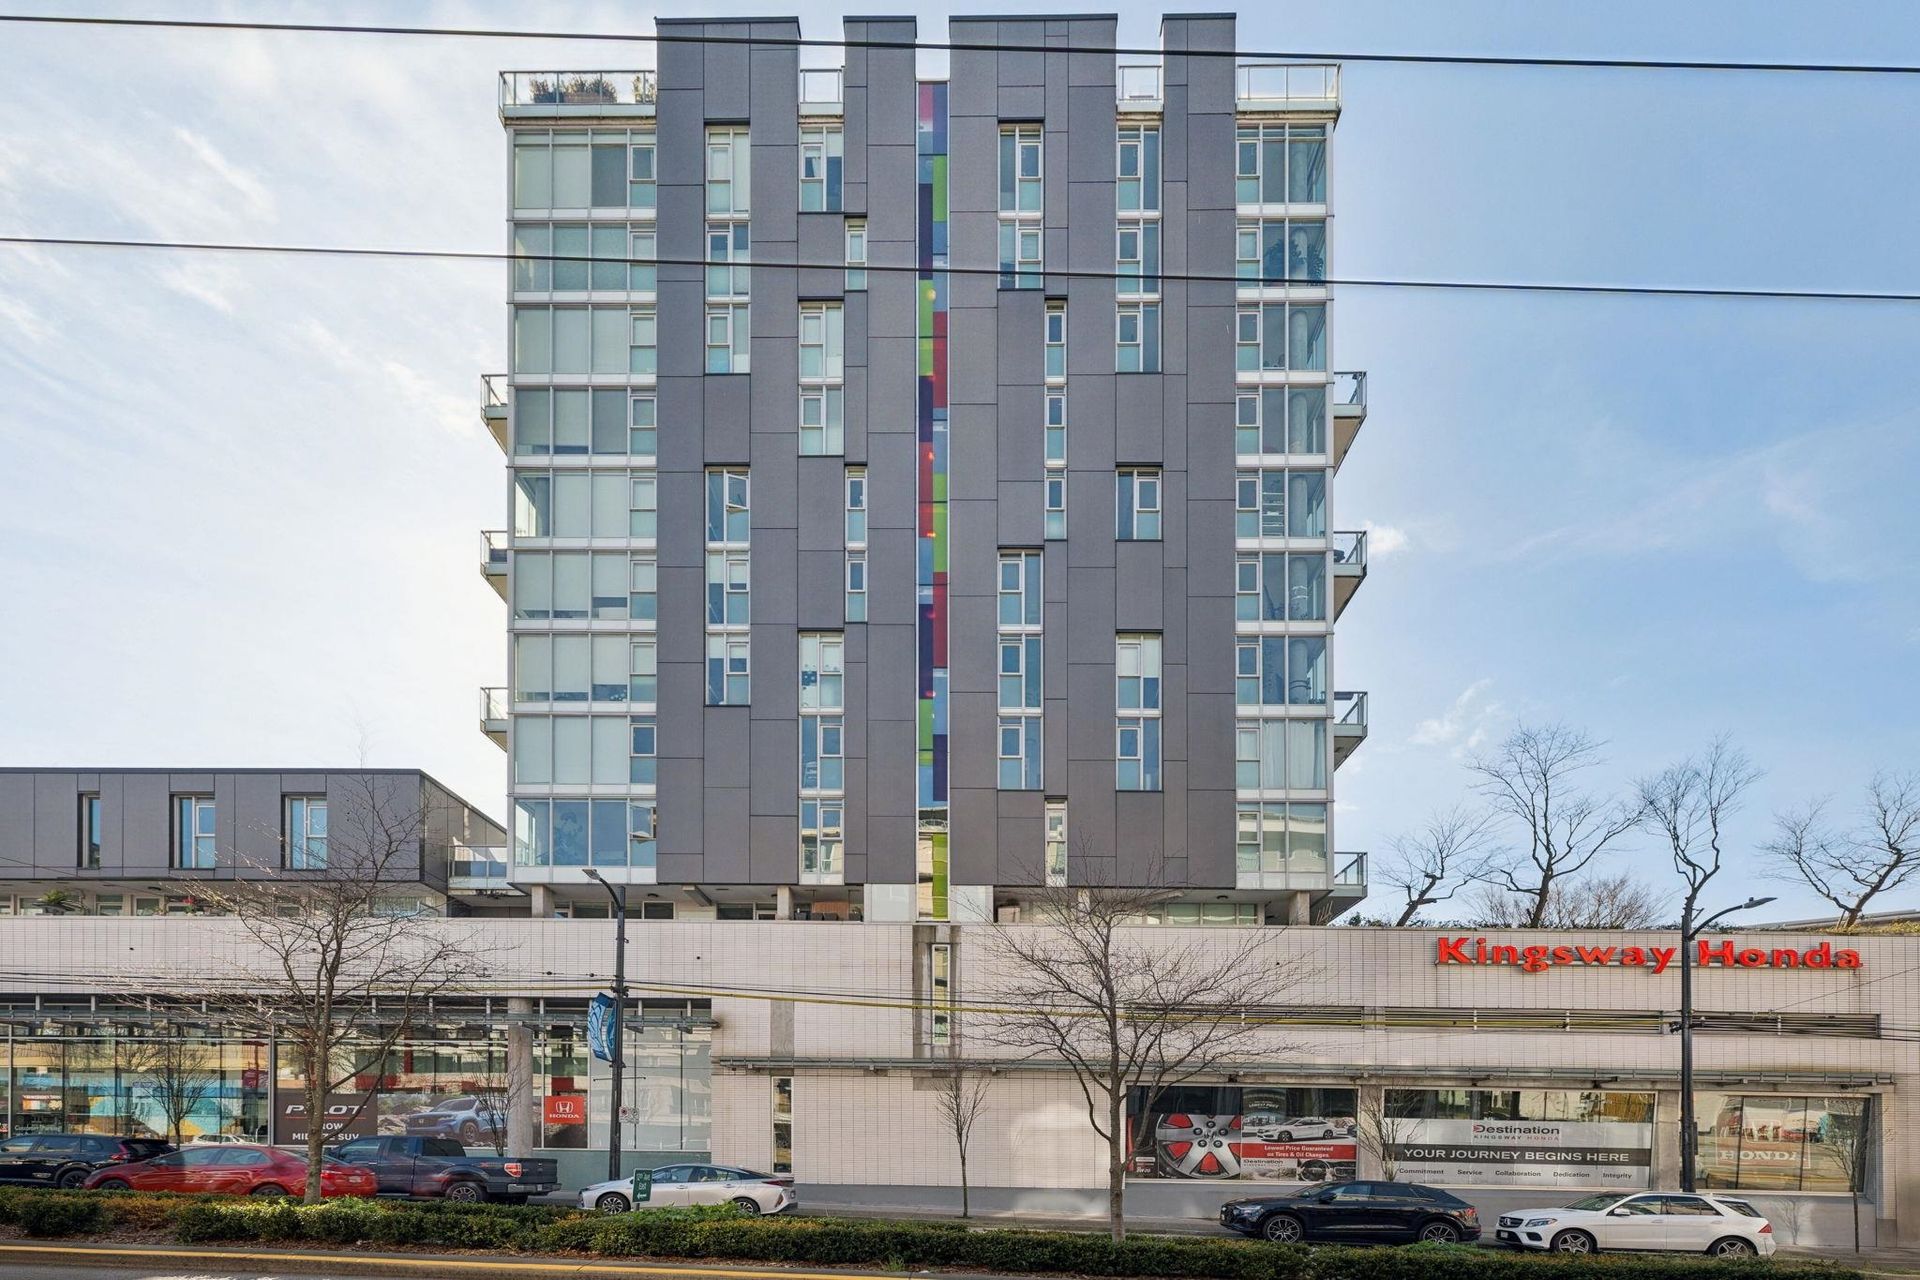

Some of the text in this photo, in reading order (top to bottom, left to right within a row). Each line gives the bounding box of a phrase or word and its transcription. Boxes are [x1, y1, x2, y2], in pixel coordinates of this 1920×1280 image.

[1437, 937, 1863, 974] Kingsway Honda
[285, 1104, 367, 1115] POT
[1473, 1124, 1560, 1134] Destination
[338, 1133, 360, 1141] SUV
[1404, 1149, 1630, 1162] YOUR JOURNEY BEGINS HERE
